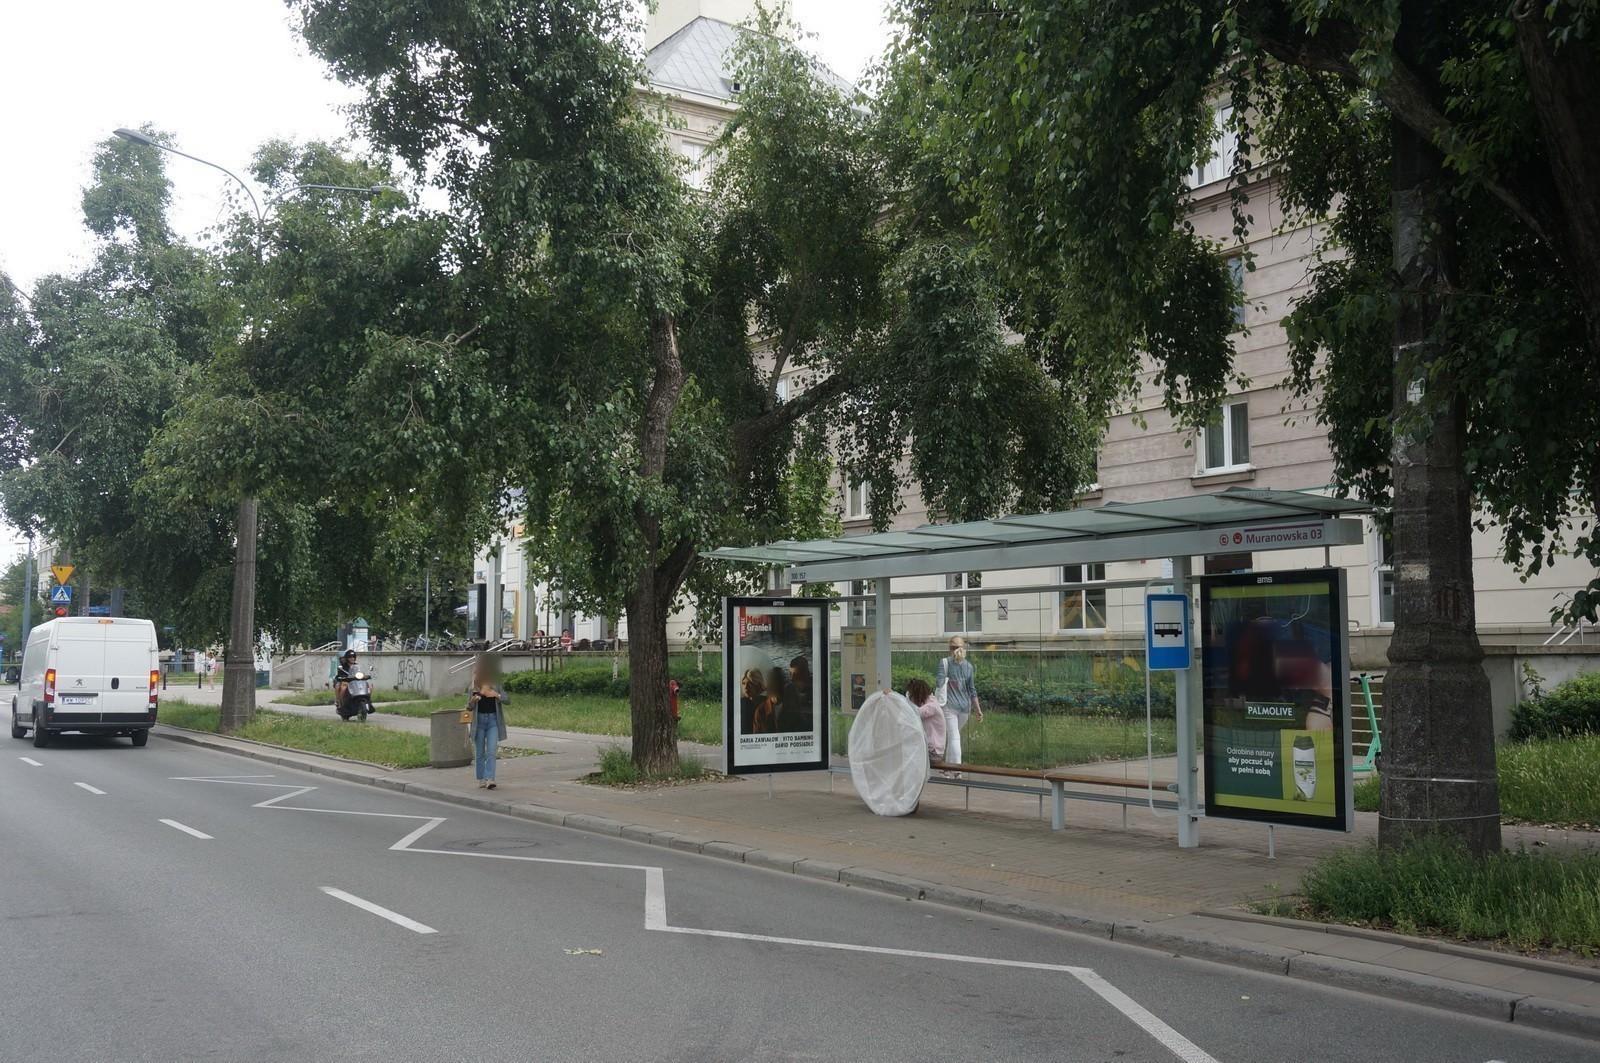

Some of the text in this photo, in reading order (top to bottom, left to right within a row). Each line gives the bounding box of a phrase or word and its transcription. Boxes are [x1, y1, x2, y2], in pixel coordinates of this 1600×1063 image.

[1246, 530, 1308, 544] Muranowska
[1310, 529, 1322, 539] 03
[1247, 706, 1293, 716] PALMOLIVE
[1226, 747, 1275, 758] Odrobina natury
[1228, 757, 1273, 767] aby poczuć się
[1238, 766, 1254, 775] pełni
[1255, 767, 1271, 777] sobą
